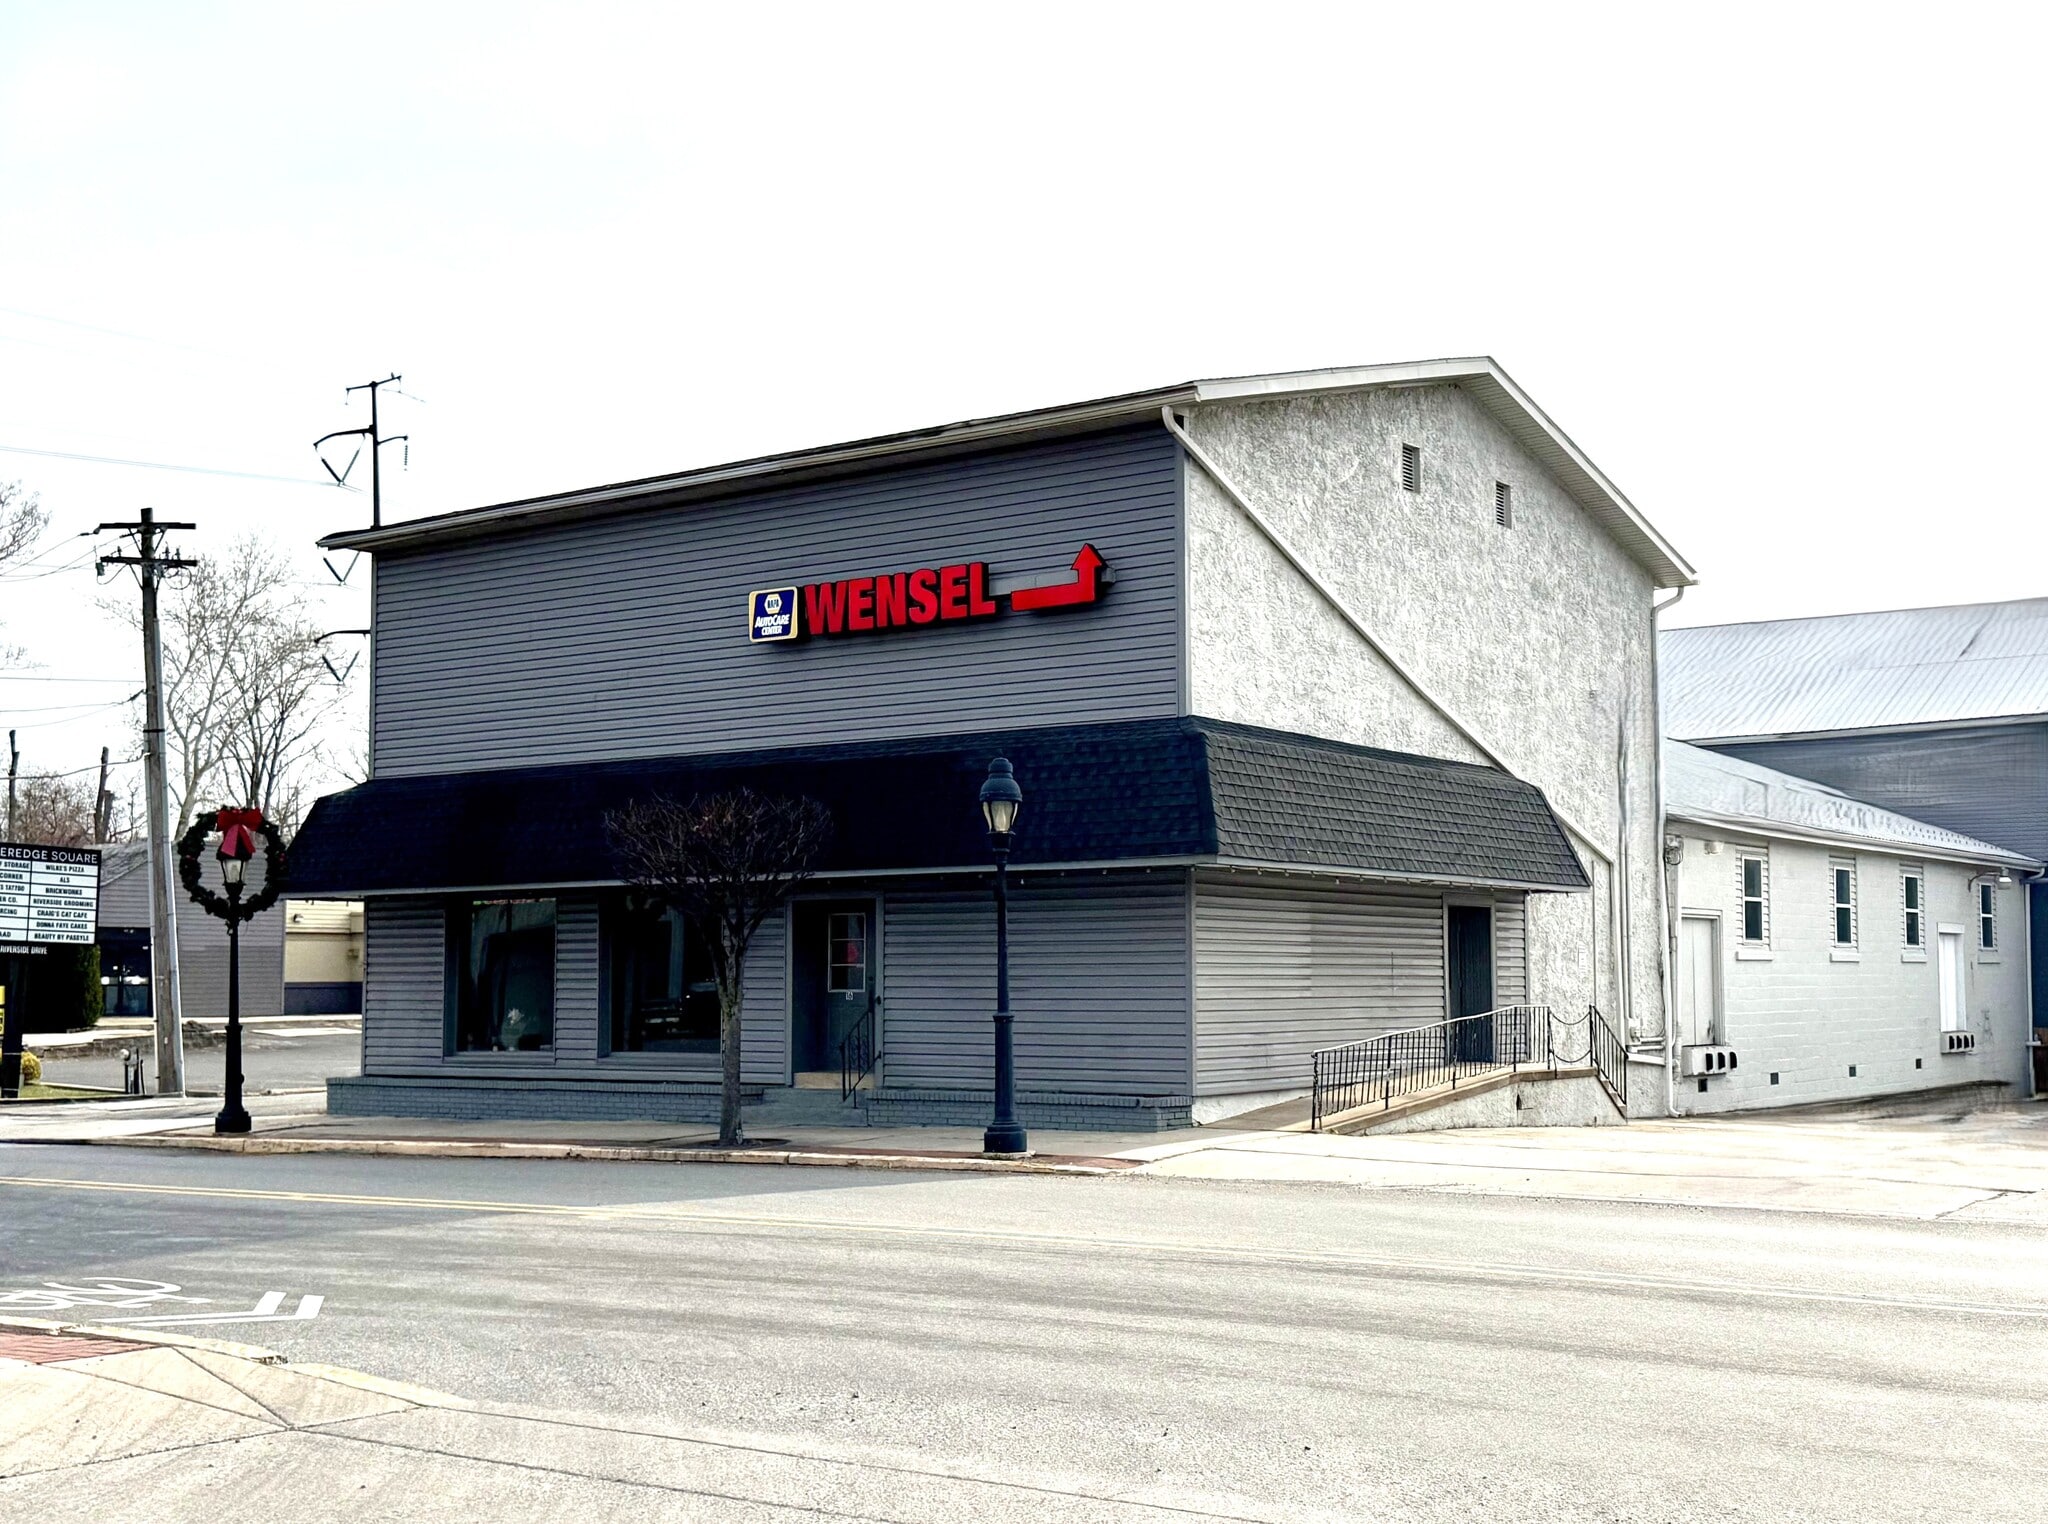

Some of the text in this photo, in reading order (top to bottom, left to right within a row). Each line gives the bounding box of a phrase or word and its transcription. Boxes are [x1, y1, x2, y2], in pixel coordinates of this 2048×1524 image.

[804, 562, 996, 635] WENSEL
[761, 625, 783, 636] CENTER
[0, 847, 98, 864] EREDGE SQUARE
[4, 861, 30, 869] STORAGE
[0, 872, 23, 880] CORNER
[5, 884, 25, 892] TATTOO
[45, 887, 82, 896] BRICKWORKS
[33, 898, 62, 906] RIVERSIDE
[37, 909, 60, 917] CRAIG'S
[34, 932, 56, 940] BEAUTY
[30, 946, 48, 955] DRIVE
